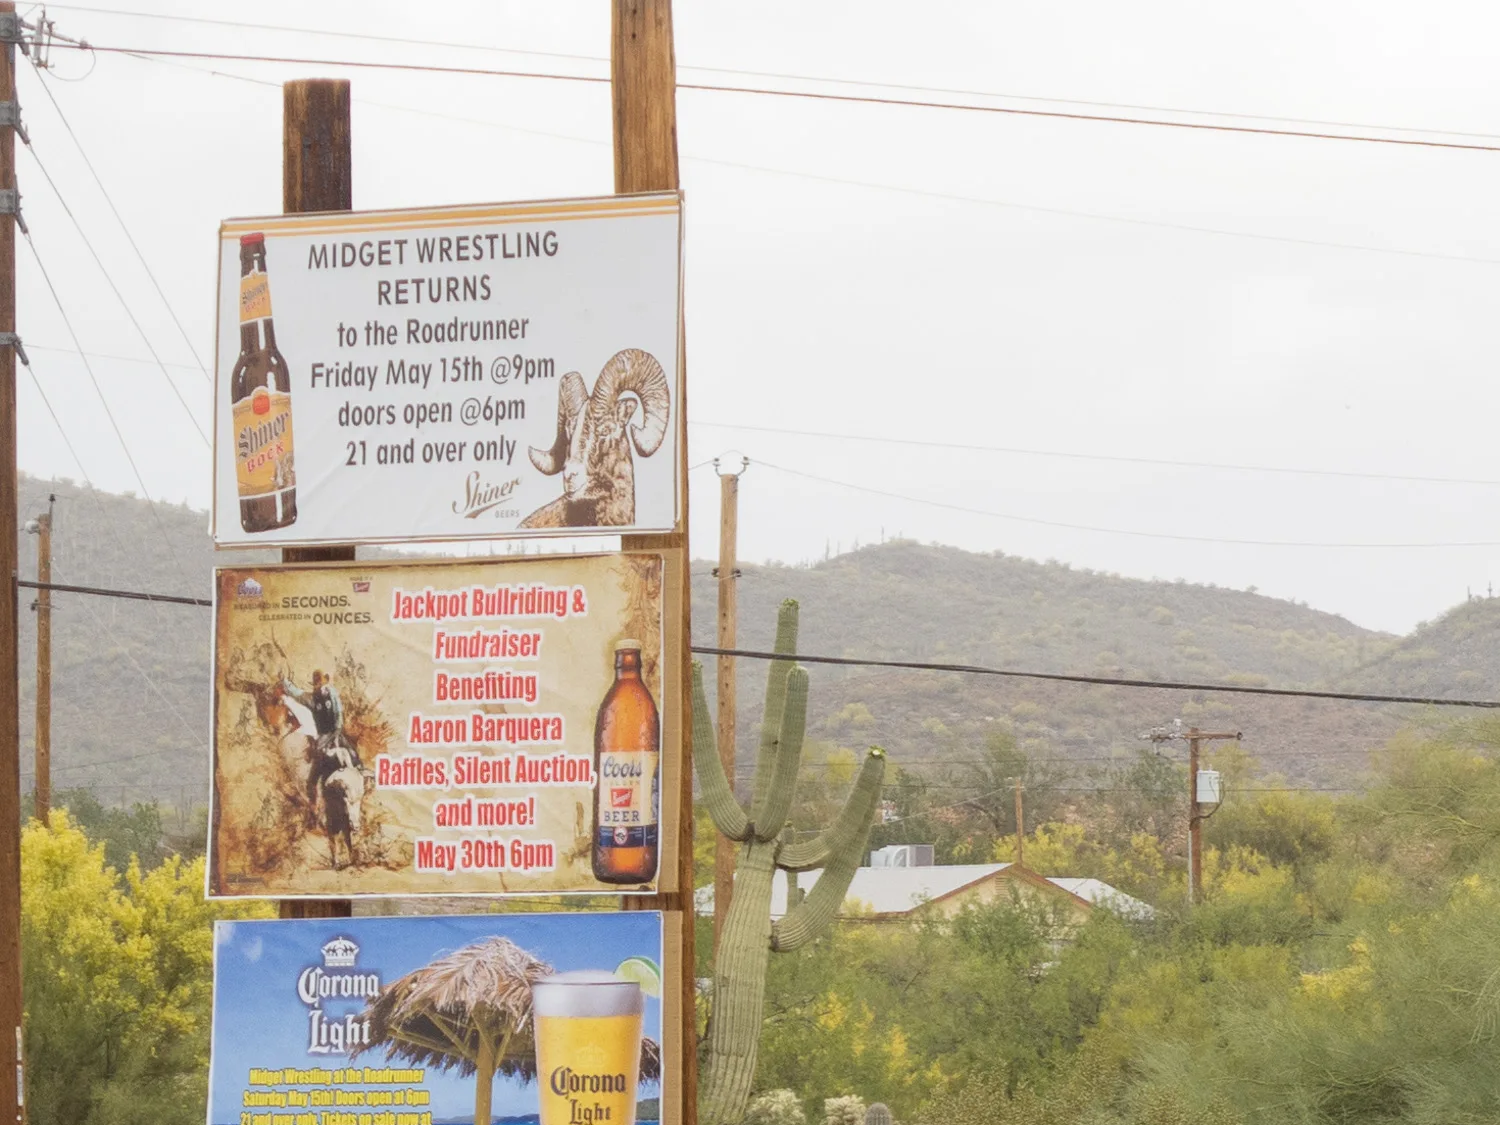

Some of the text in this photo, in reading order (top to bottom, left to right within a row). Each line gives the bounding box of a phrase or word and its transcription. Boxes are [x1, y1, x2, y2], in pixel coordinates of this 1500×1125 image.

[308, 230, 559, 269] MIDGET WRESTLING
[378, 274, 491, 305] RETURNS
[337, 316, 529, 347] to the Roadrunner
[311, 354, 555, 391] Friday May 15th @9pm
[338, 396, 525, 428] doors open @6pm
[346, 435, 516, 466] 21 and over only
[452, 471, 523, 516] Shiner
[494, 510, 520, 518] BEERS
[282, 595, 351, 608] SECONDS.
[393, 587, 585, 620] Jackpot Bullriding &
[313, 612, 374, 625] OUNCES.
[435, 630, 540, 659] Fundraiser
[436, 672, 537, 702] Benefiting
[410, 714, 562, 744] Aaron Barquera
[378, 755, 594, 786] Raffles, Silent Auction,
[603, 756, 642, 778] Coors
[435, 798, 535, 826] and more!
[604, 811, 640, 822] BEER
[418, 839, 553, 871] May 30th 6pm
[298, 967, 380, 1008] Corona
[308, 1010, 371, 1053] Light
[249, 1067, 424, 1086] Midget Wrestling at the Roadrunner
[551, 1066, 626, 1099] Corona
[243, 1089, 430, 1107] Saturday May 15th! Doors open at 6pm
[569, 1099, 611, 1125] Light
